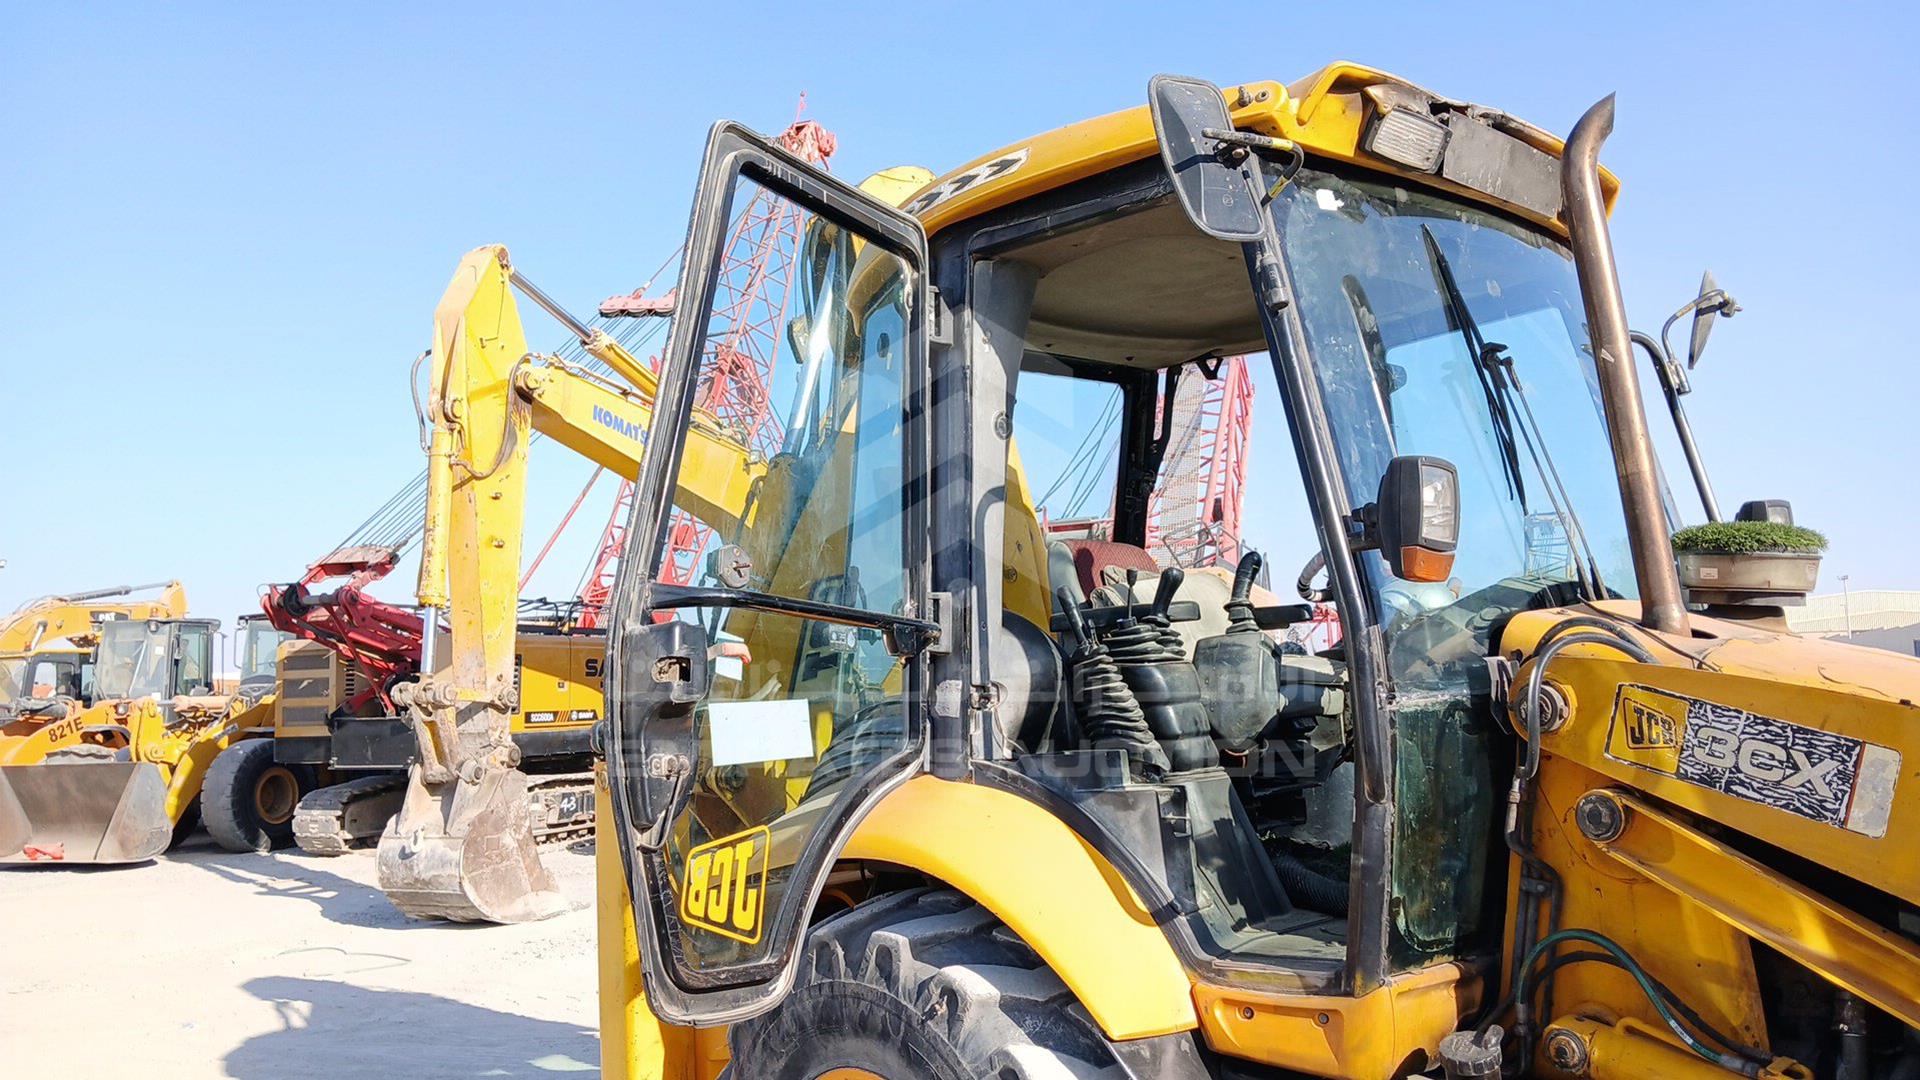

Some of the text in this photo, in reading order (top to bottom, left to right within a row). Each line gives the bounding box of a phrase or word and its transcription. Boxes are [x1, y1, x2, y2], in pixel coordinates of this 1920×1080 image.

[48, 716, 85, 743] 821E
[1629, 704, 1675, 745] JCB
[1693, 727, 1844, 800] 3CX
